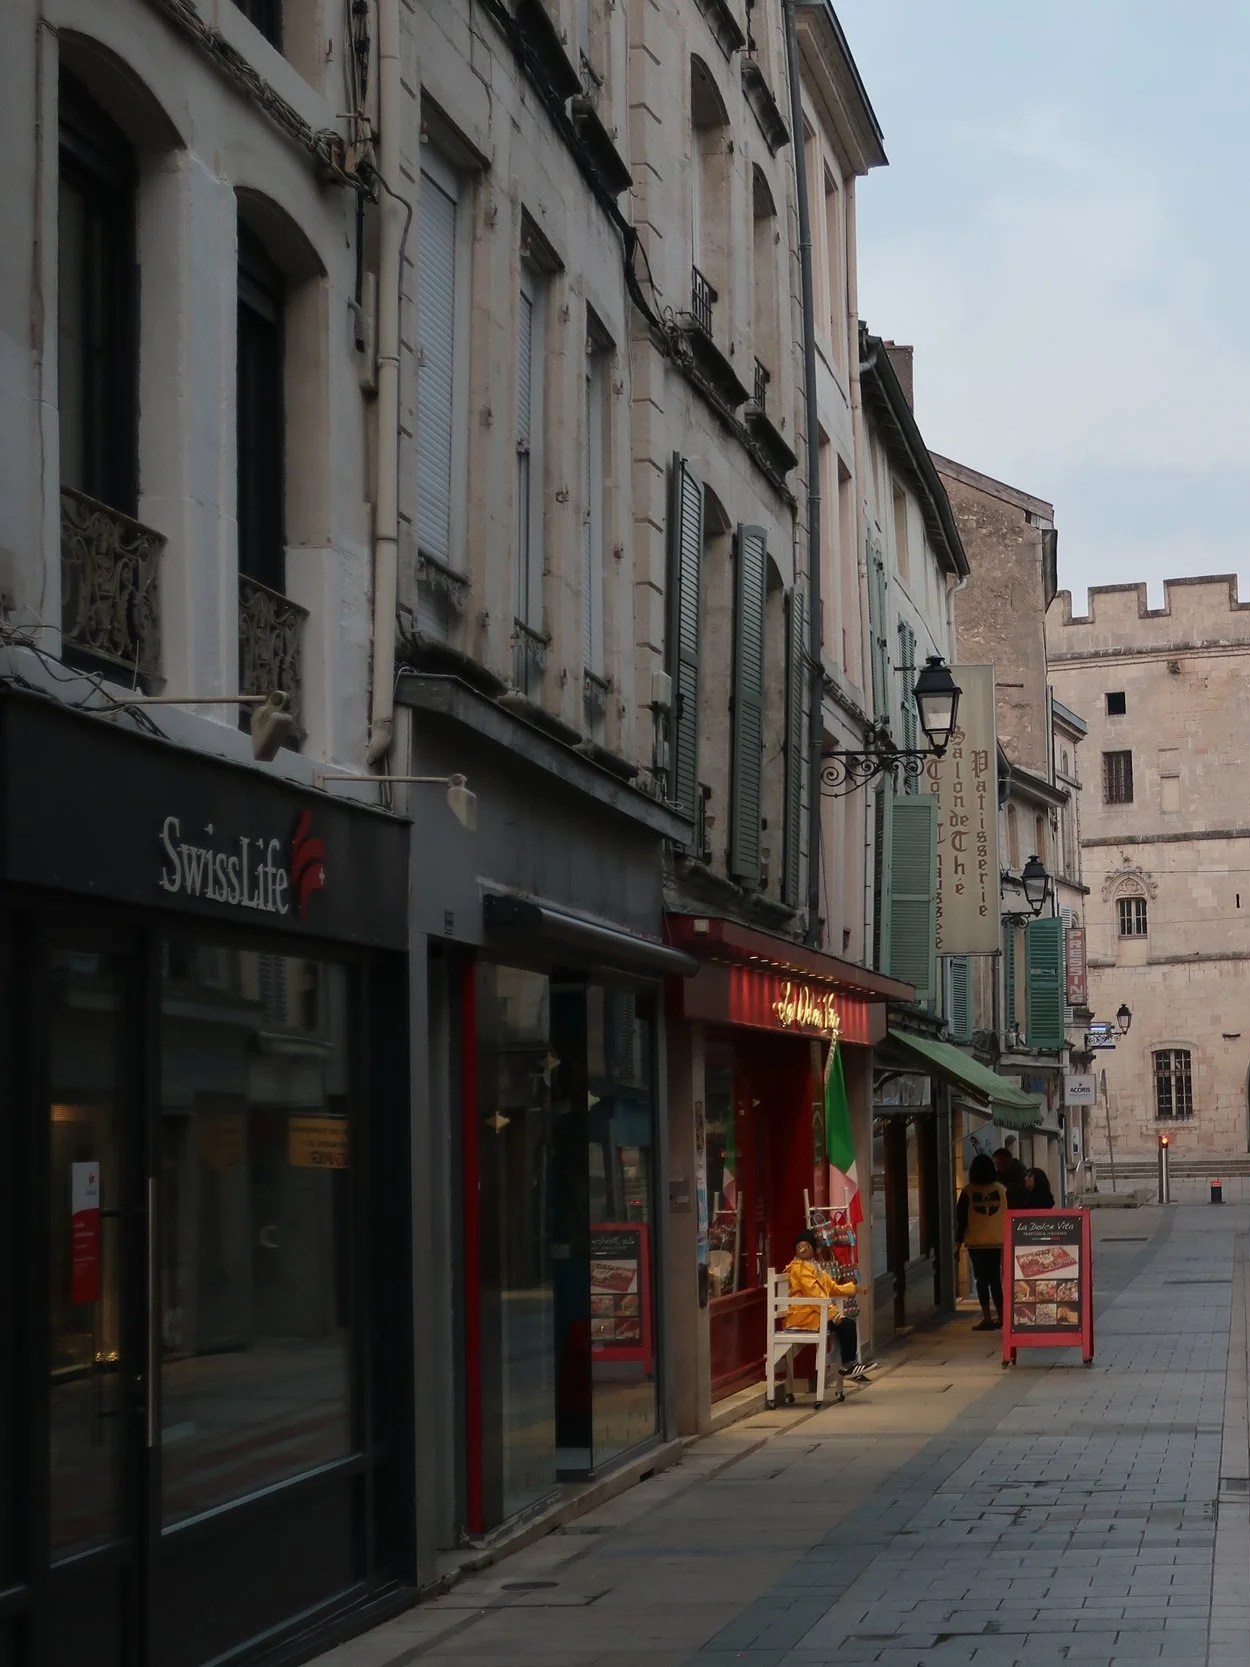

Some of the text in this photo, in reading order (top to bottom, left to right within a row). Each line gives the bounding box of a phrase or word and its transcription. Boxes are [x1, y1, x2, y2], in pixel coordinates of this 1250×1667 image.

[949, 724, 971, 896] Salon de Thé
[158, 815, 290, 915] SwissLife
[1069, 929, 1084, 1005] PRESSING
[1016, 1221, 1028, 1231] La
[1029, 1221, 1055, 1231] Dolce
